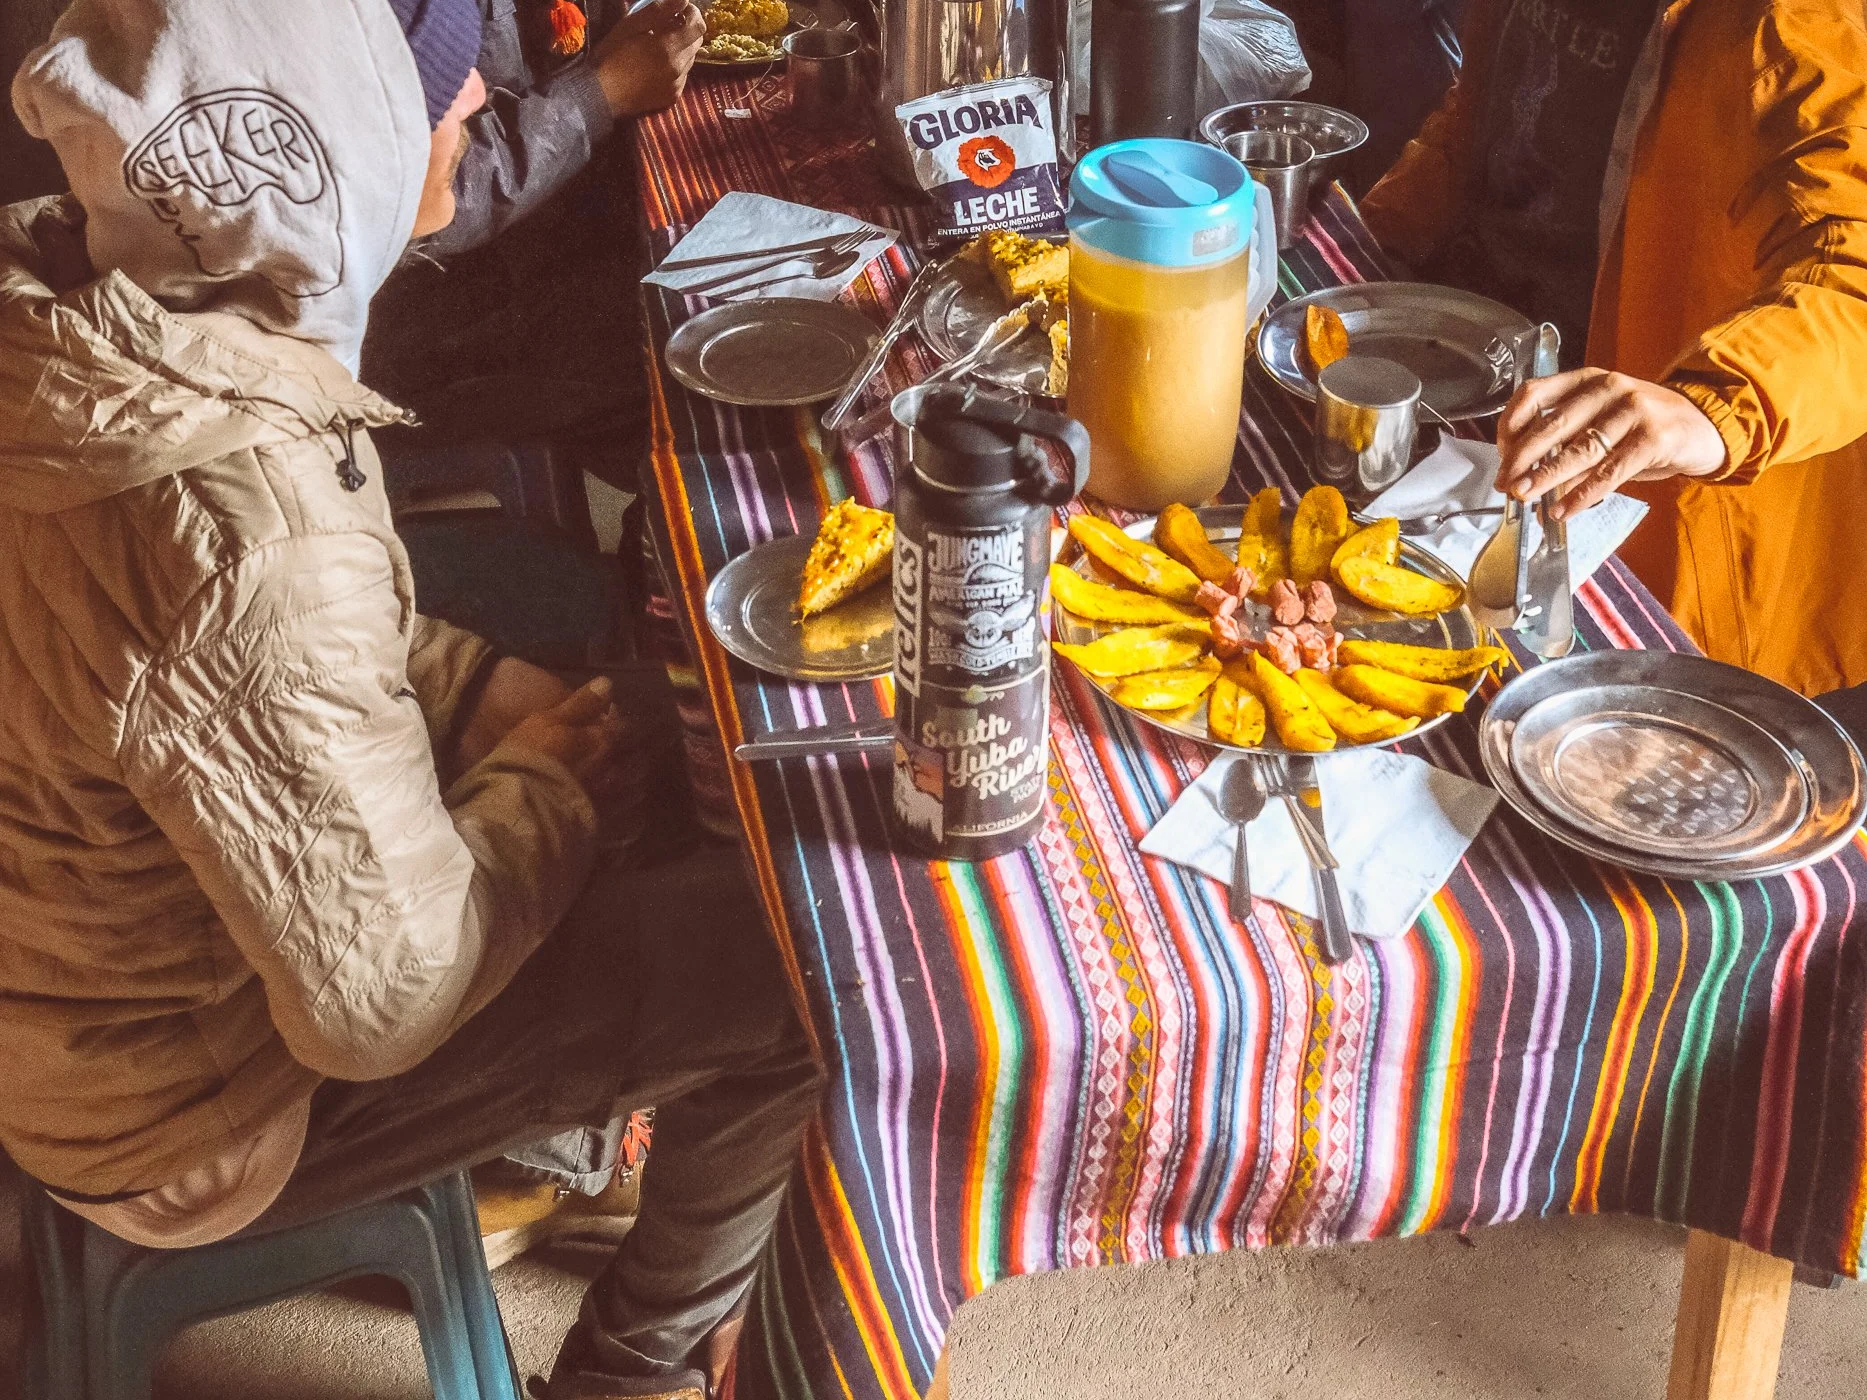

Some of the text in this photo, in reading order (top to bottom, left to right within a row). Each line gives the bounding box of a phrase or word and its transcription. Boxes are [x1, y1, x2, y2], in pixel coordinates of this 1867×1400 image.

[909, 94, 1043, 150] GLORIA
[138, 105, 309, 194] SEEKER
[937, 210, 1061, 236] ENTERA EN POLVO INSTANTÁNEA
[953, 186, 1041, 226] LECHE
[922, 713, 1012, 748] South
[948, 736, 1028, 788] Yuba
